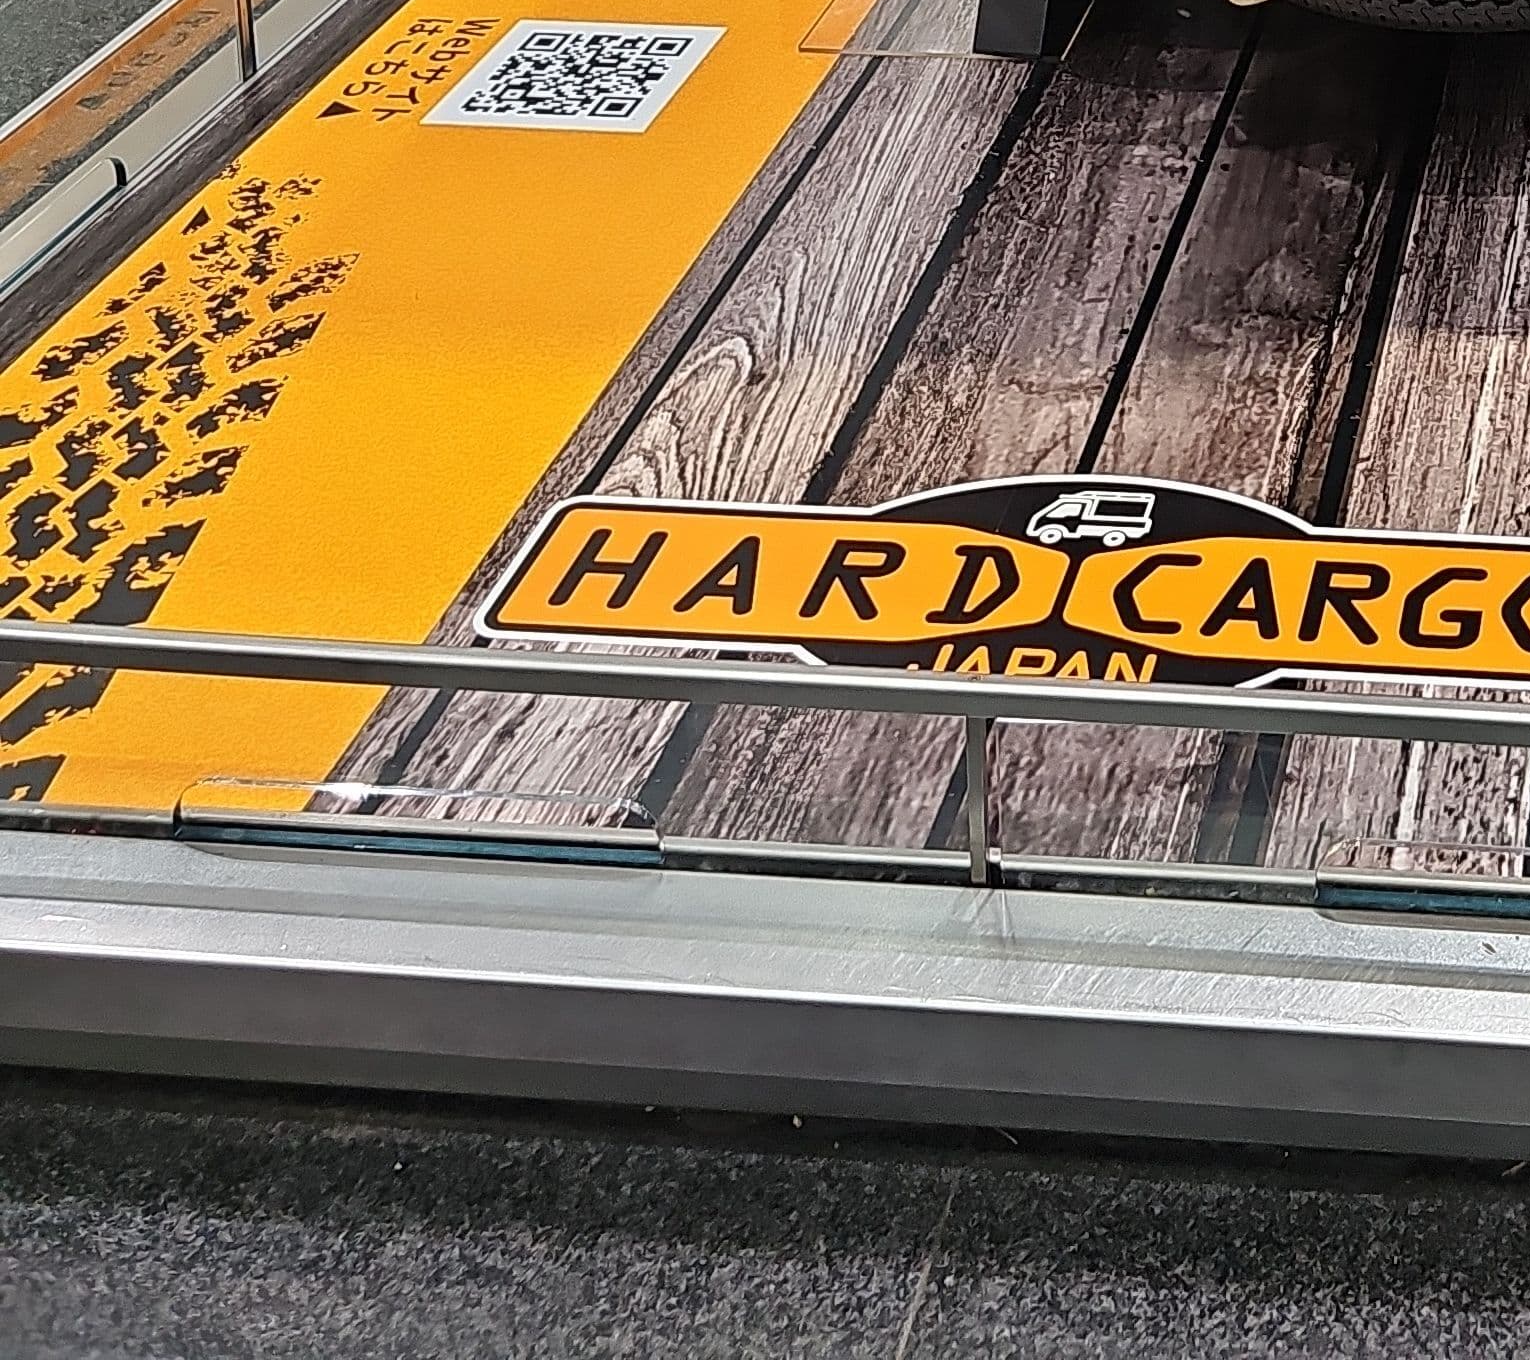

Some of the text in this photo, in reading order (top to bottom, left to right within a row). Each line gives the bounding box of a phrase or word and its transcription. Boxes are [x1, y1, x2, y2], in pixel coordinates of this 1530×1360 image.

[343, 19, 453, 97] はこちら
[372, 19, 501, 122] Webサイト
[547, 527, 1020, 628] HARD
[906, 643, 1158, 683] JAPAN
